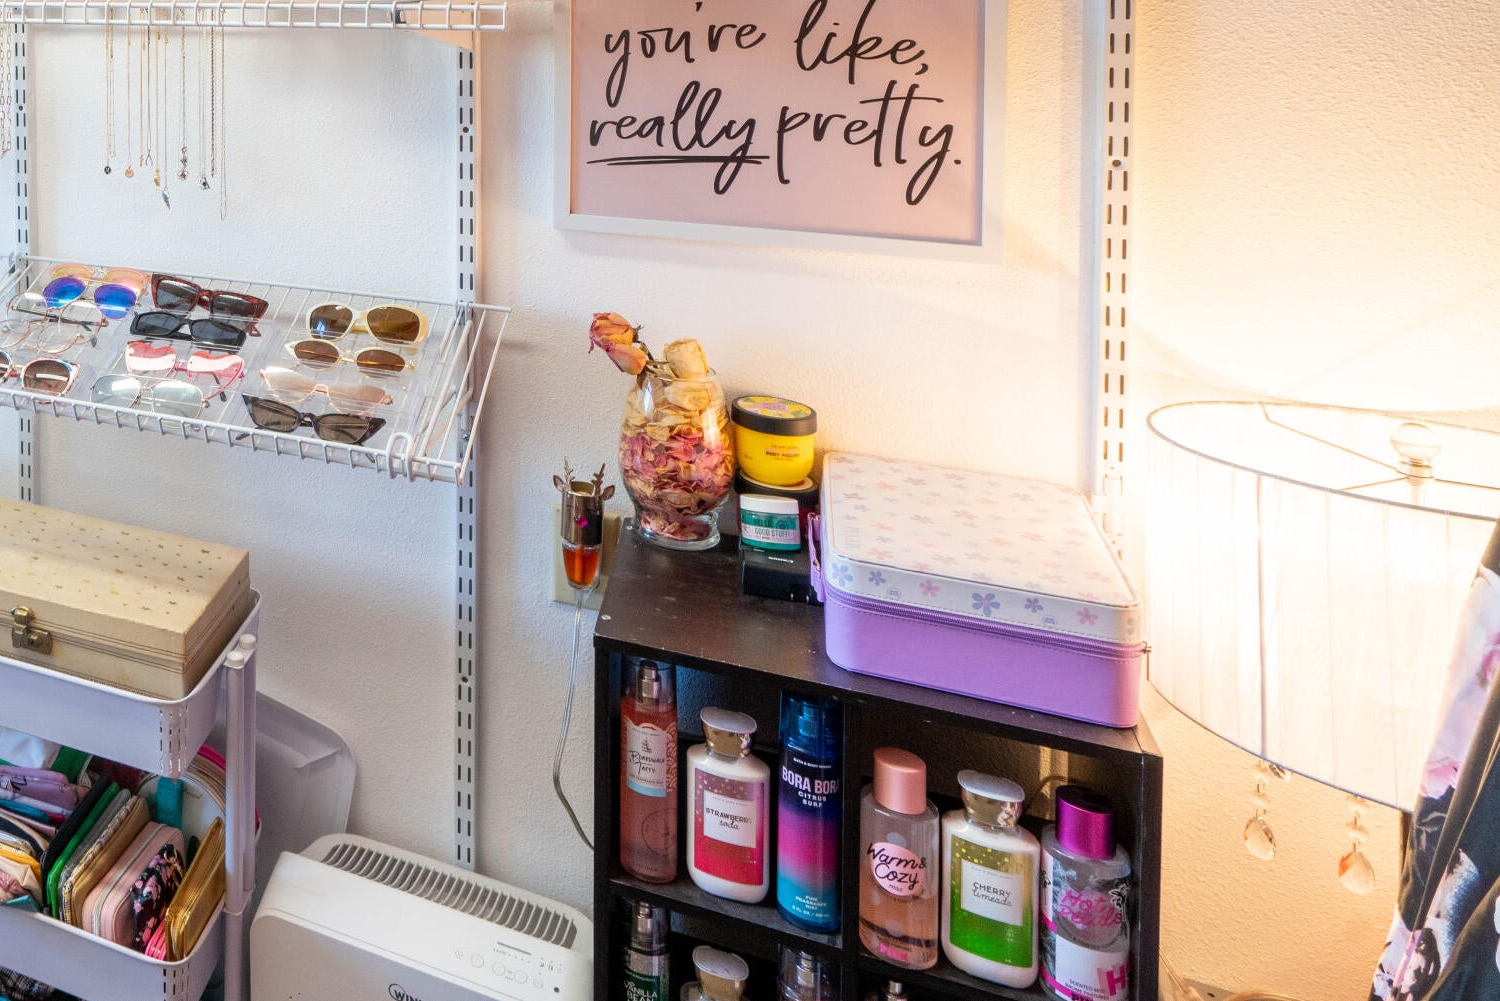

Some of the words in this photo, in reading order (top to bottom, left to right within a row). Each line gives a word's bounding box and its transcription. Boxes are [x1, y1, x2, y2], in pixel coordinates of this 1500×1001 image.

[604, 1, 767, 108] you're
[588, 80, 758, 195] really
[776, 79, 963, 206] pretty.
[782, 764, 812, 793] BORA
[798, 790, 827, 802] CITRUS
[802, 798, 823, 808] SURF
[866, 842, 918, 870] Warm
[874, 862, 919, 891] Cozy
[973, 881, 1012, 898] CHERRY
[623, 980, 658, 998] VANILLA
